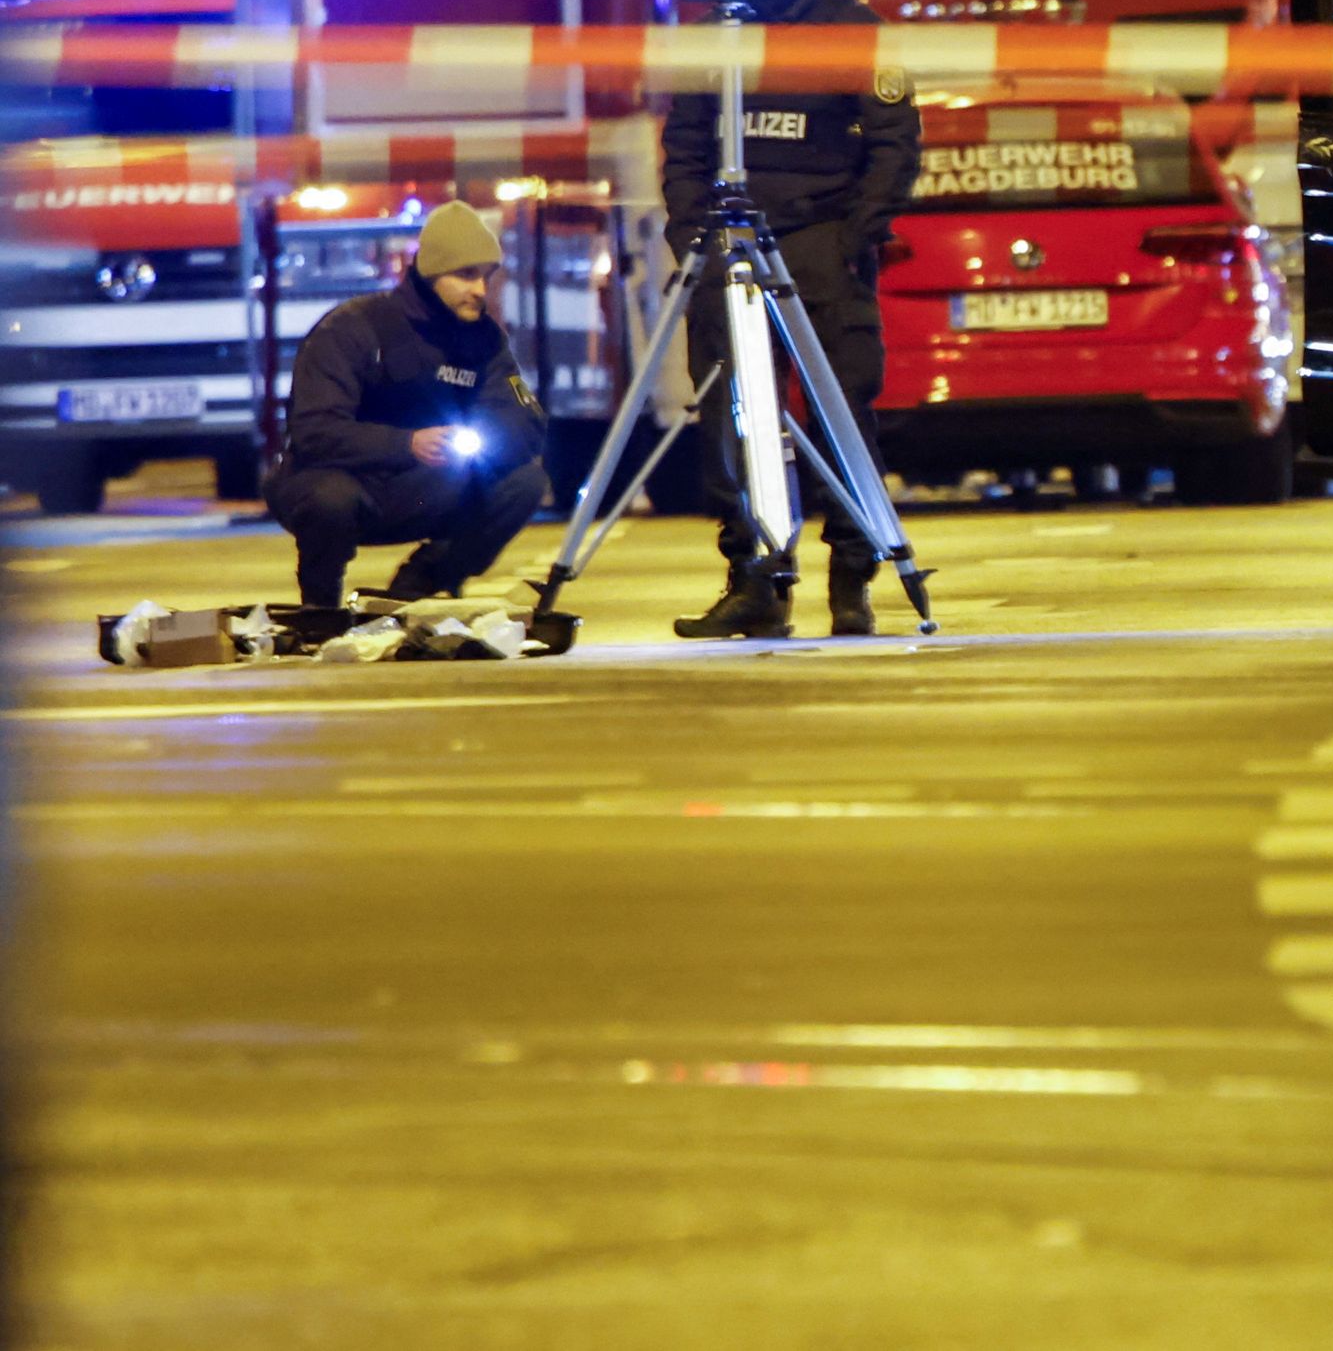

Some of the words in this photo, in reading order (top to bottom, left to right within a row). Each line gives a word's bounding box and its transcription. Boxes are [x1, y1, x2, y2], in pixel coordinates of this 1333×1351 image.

[719, 110, 806, 139] LIZEI
[911, 167, 1138, 197] MAGDEBURG
[437, 365, 477, 388] POLIZEI
